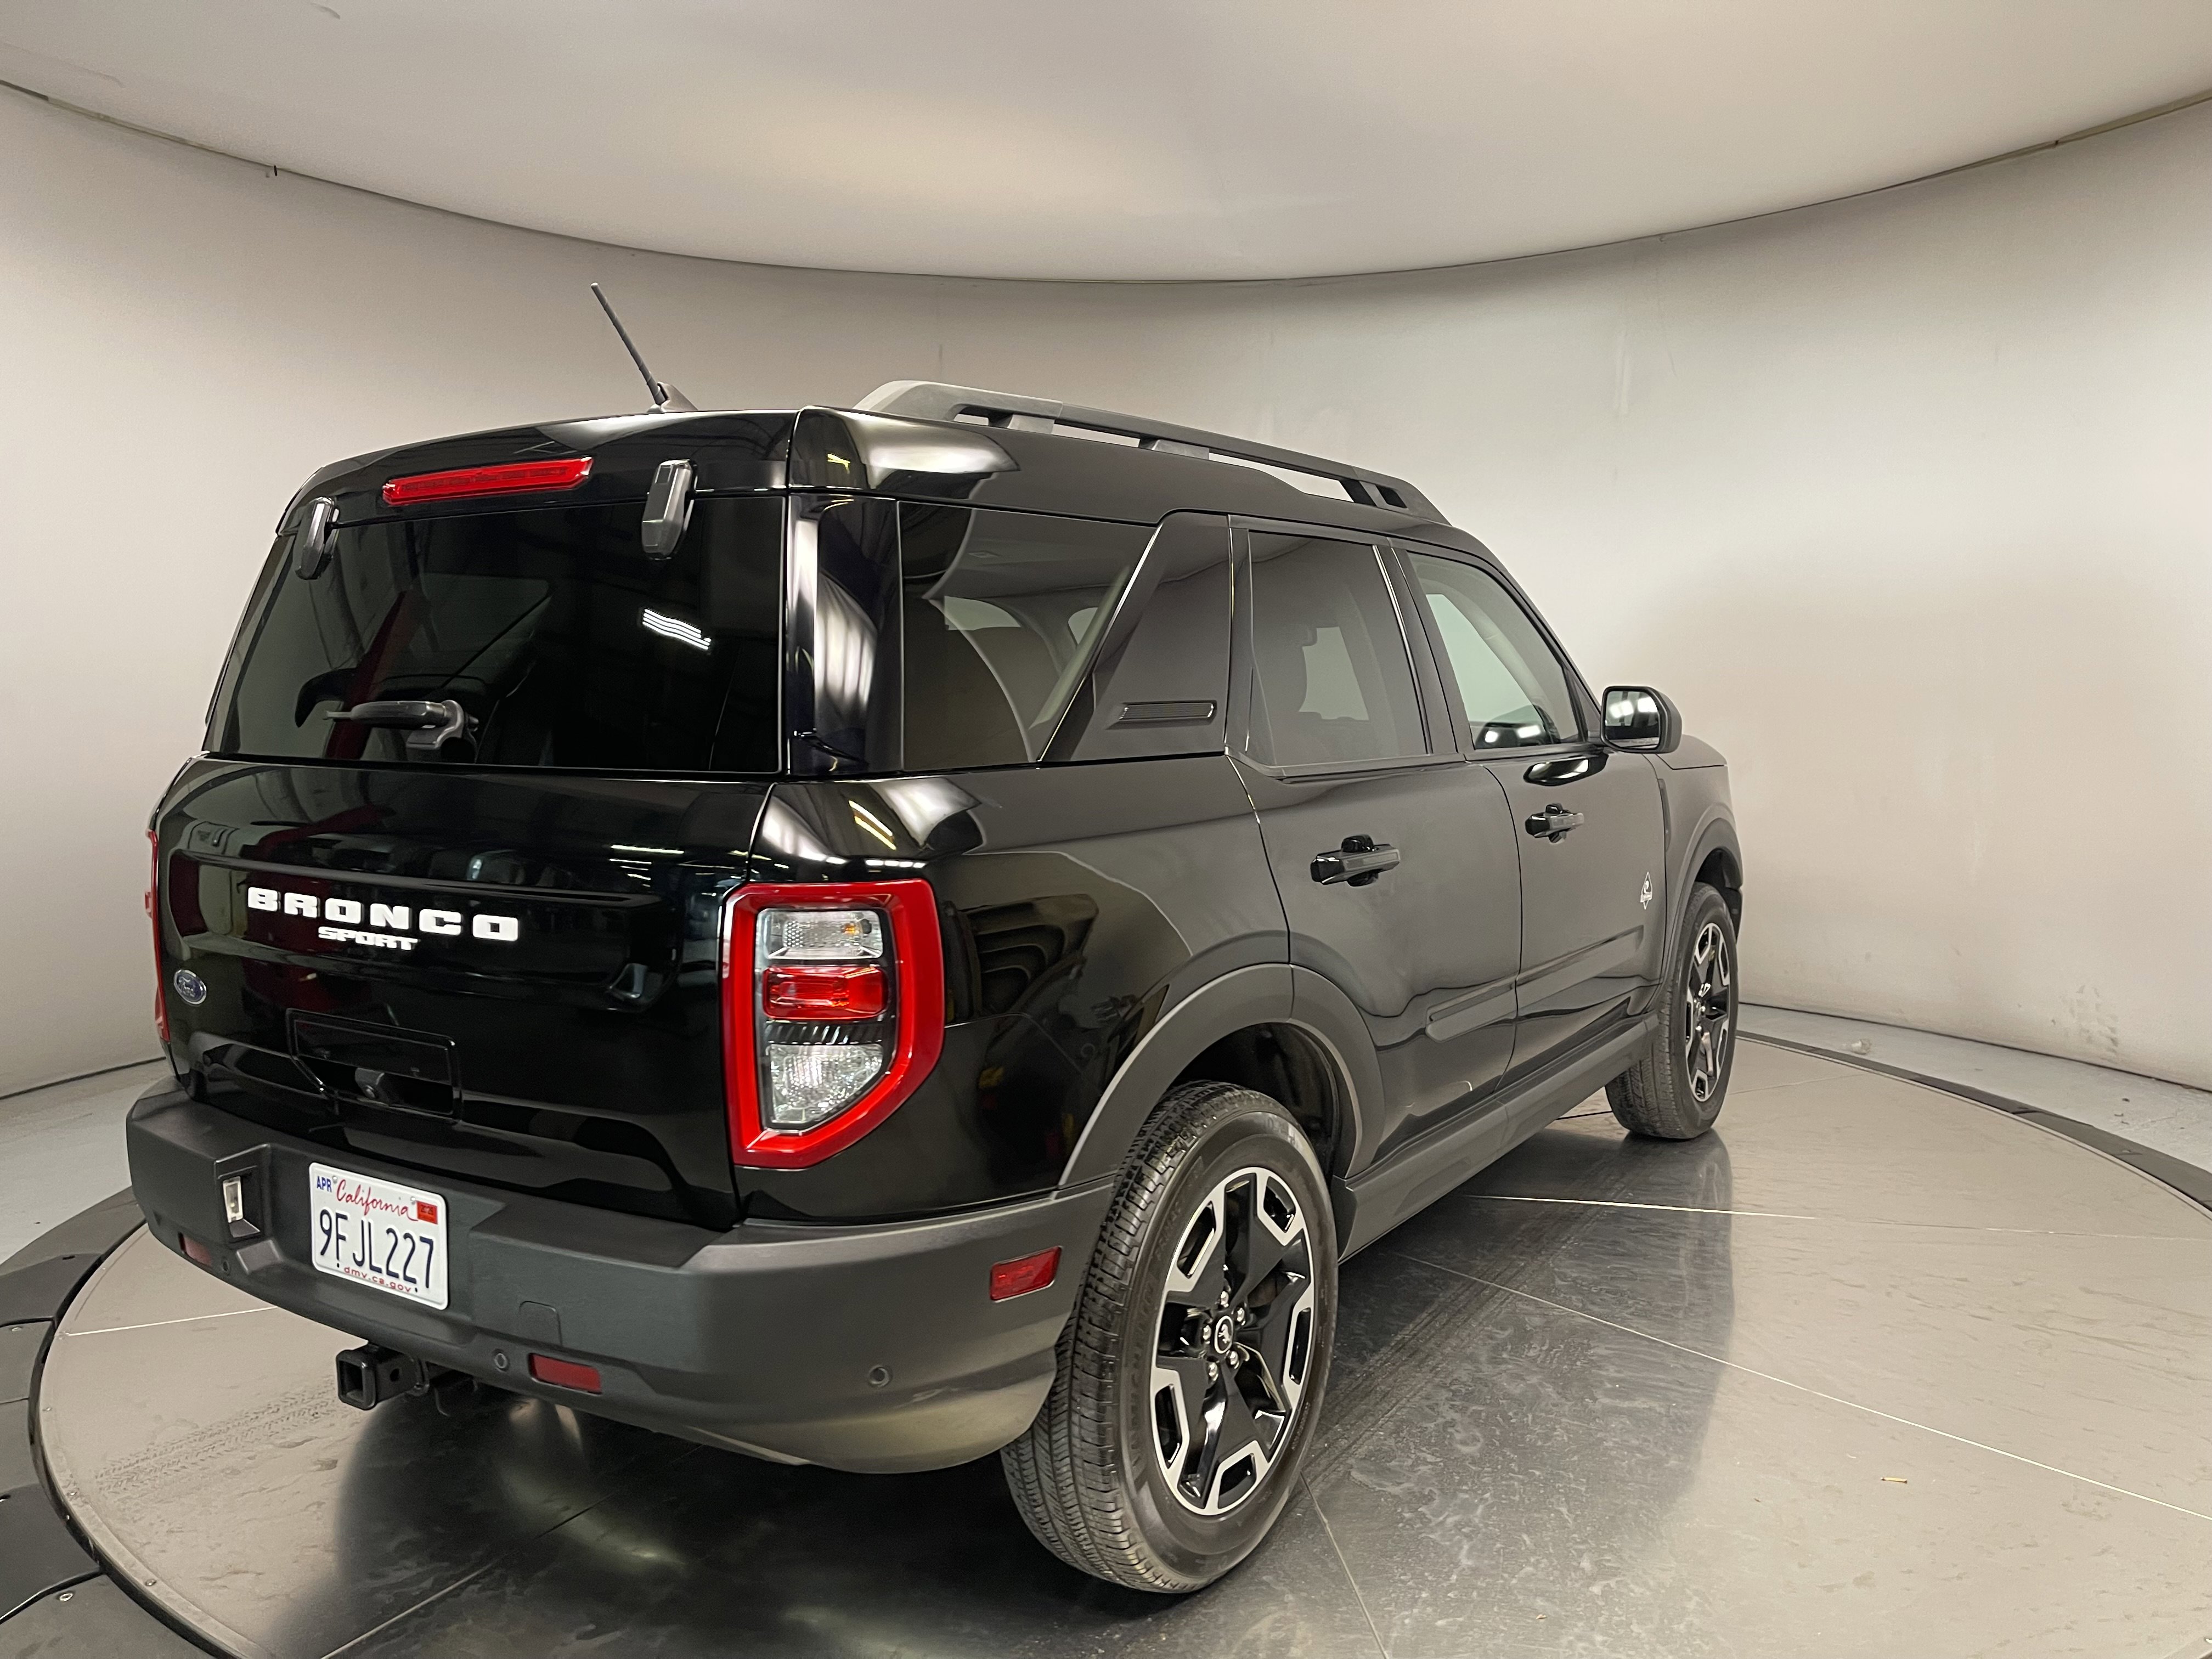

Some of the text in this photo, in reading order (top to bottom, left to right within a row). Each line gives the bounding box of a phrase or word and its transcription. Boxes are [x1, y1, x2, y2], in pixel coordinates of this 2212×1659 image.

[247, 887, 518, 941] BRONCO
[318, 926, 420, 950] SPORT
[317, 1176, 332, 1193] APR
[336, 1179, 418, 1221] California
[320, 1209, 433, 1289] 9FJL227
[343, 1266, 411, 1293] dmv.ca.gov
